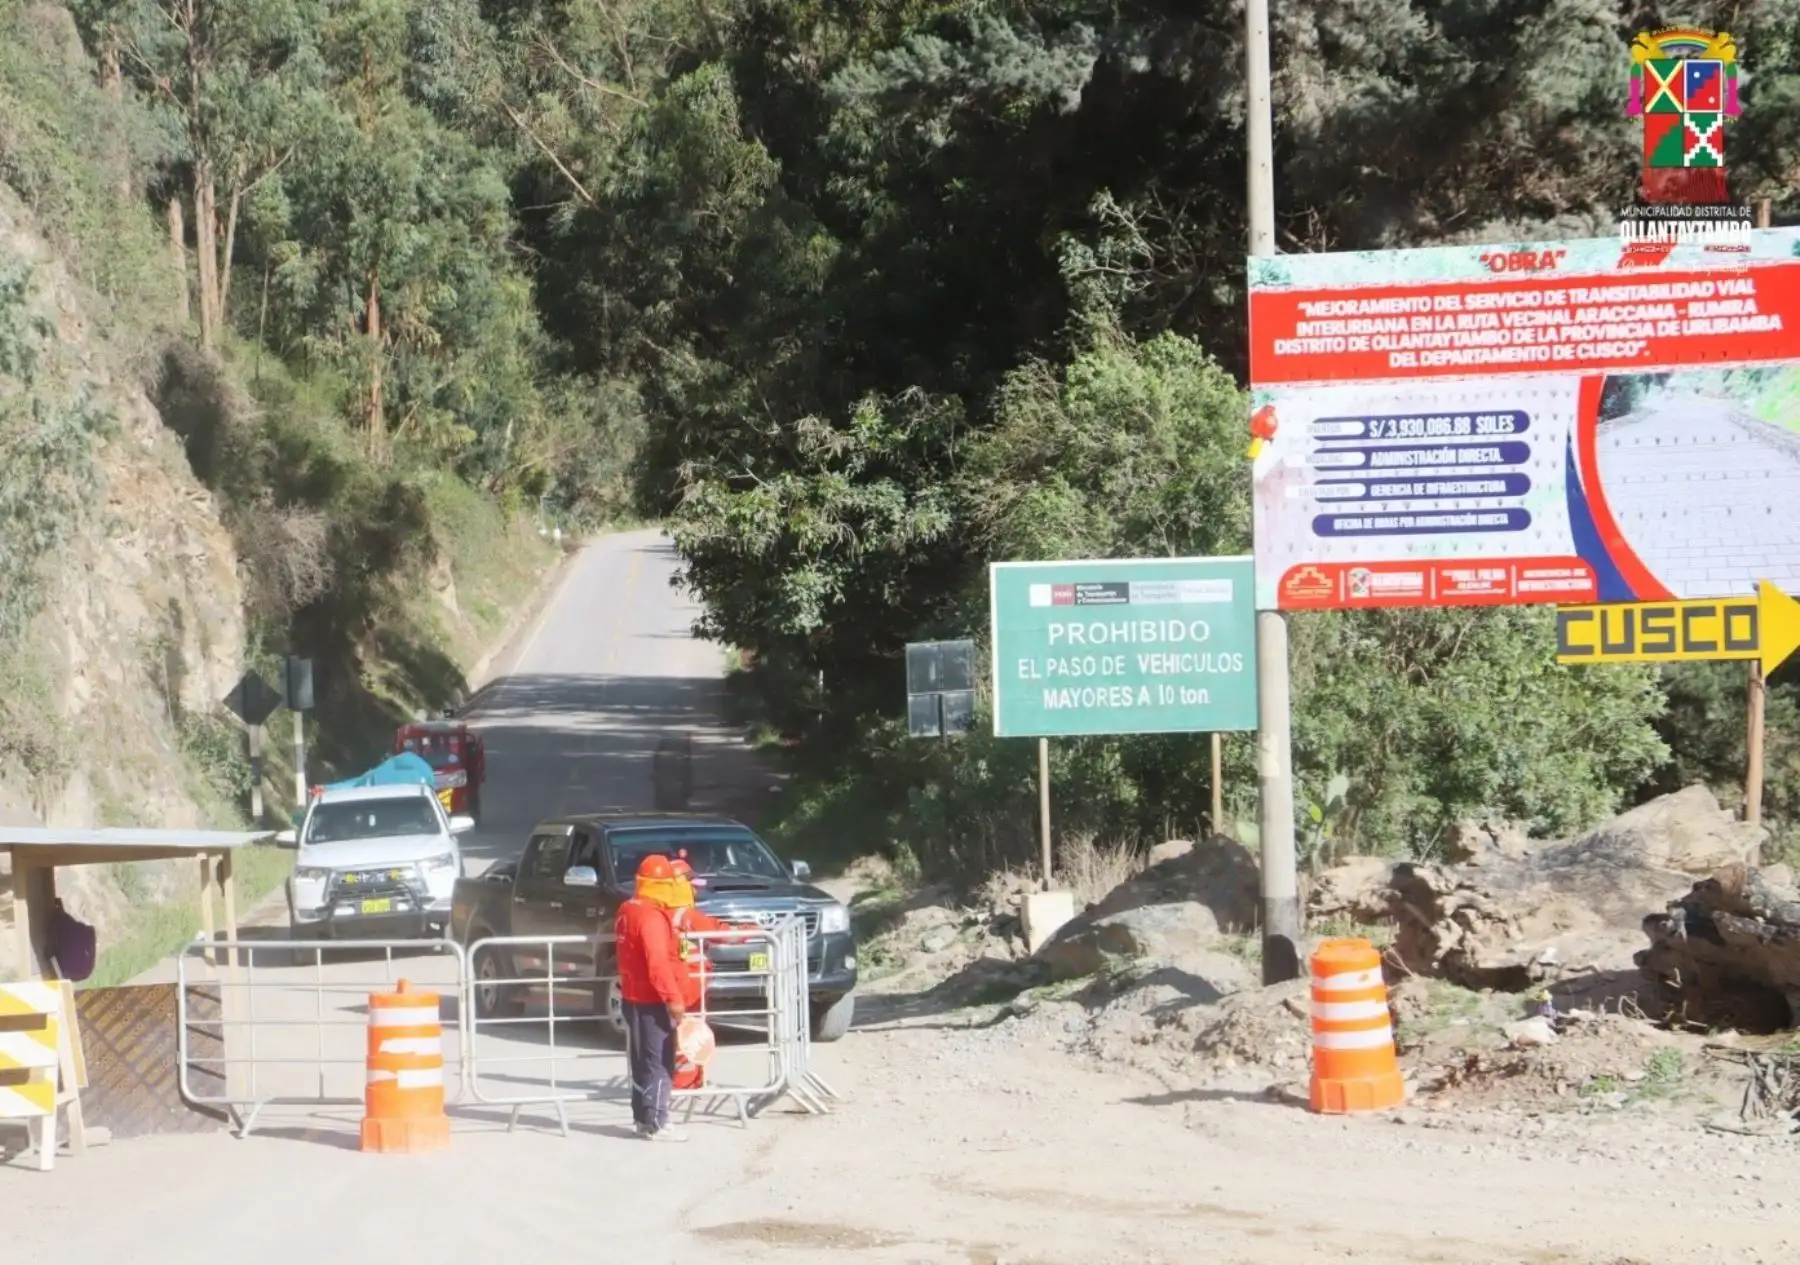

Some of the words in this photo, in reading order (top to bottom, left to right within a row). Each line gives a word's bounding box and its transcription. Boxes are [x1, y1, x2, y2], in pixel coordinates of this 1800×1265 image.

[1434, 295, 1464, 312] DEL
[1464, 291, 1540, 311] SERVICIO
[1543, 291, 1567, 306] DE
[1568, 281, 1715, 305] TRANSITABILIDAD
[1717, 278, 1757, 295] VIAL
[1296, 317, 1408, 337] INTERURBANA
[1411, 316, 1433, 331] EN
[1434, 315, 1456, 331] LA
[1457, 312, 1500, 330] RUTA
[1501, 308, 1573, 328] VECINAL
[1574, 302, 1677, 323] ARACCAMA
[1274, 337, 1345, 355] DISTRITO
[1347, 335, 1372, 352] DE
[1372, 329, 1512, 351] OLLANTAYTAMBO
[1513, 327, 1537, 345] DE
[1538, 326, 1560, 343] LA
[1561, 321, 1654, 341] PROVINCIA
[1657, 319, 1682, 337] DE
[1682, 314, 1783, 335] URUBAMBA
[1389, 351, 1419, 369] DEL
[1420, 344, 1550, 366] DEPARTAMENTO
[1552, 342, 1576, 360] DE
[1475, 414, 1516, 434] SOLES
[1048, 620, 1211, 646] PROHIBIDO
[1556, 604, 1759, 656] CUSCO
[1018, 658, 1042, 679] EL
[1046, 655, 1096, 677] PASO
[1102, 655, 1126, 676] DE
[1137, 652, 1244, 675] VEHICULOS
[1043, 686, 1133, 710] MAYORES
[1137, 687, 1152, 706] A
[1158, 684, 1175, 705] 10
